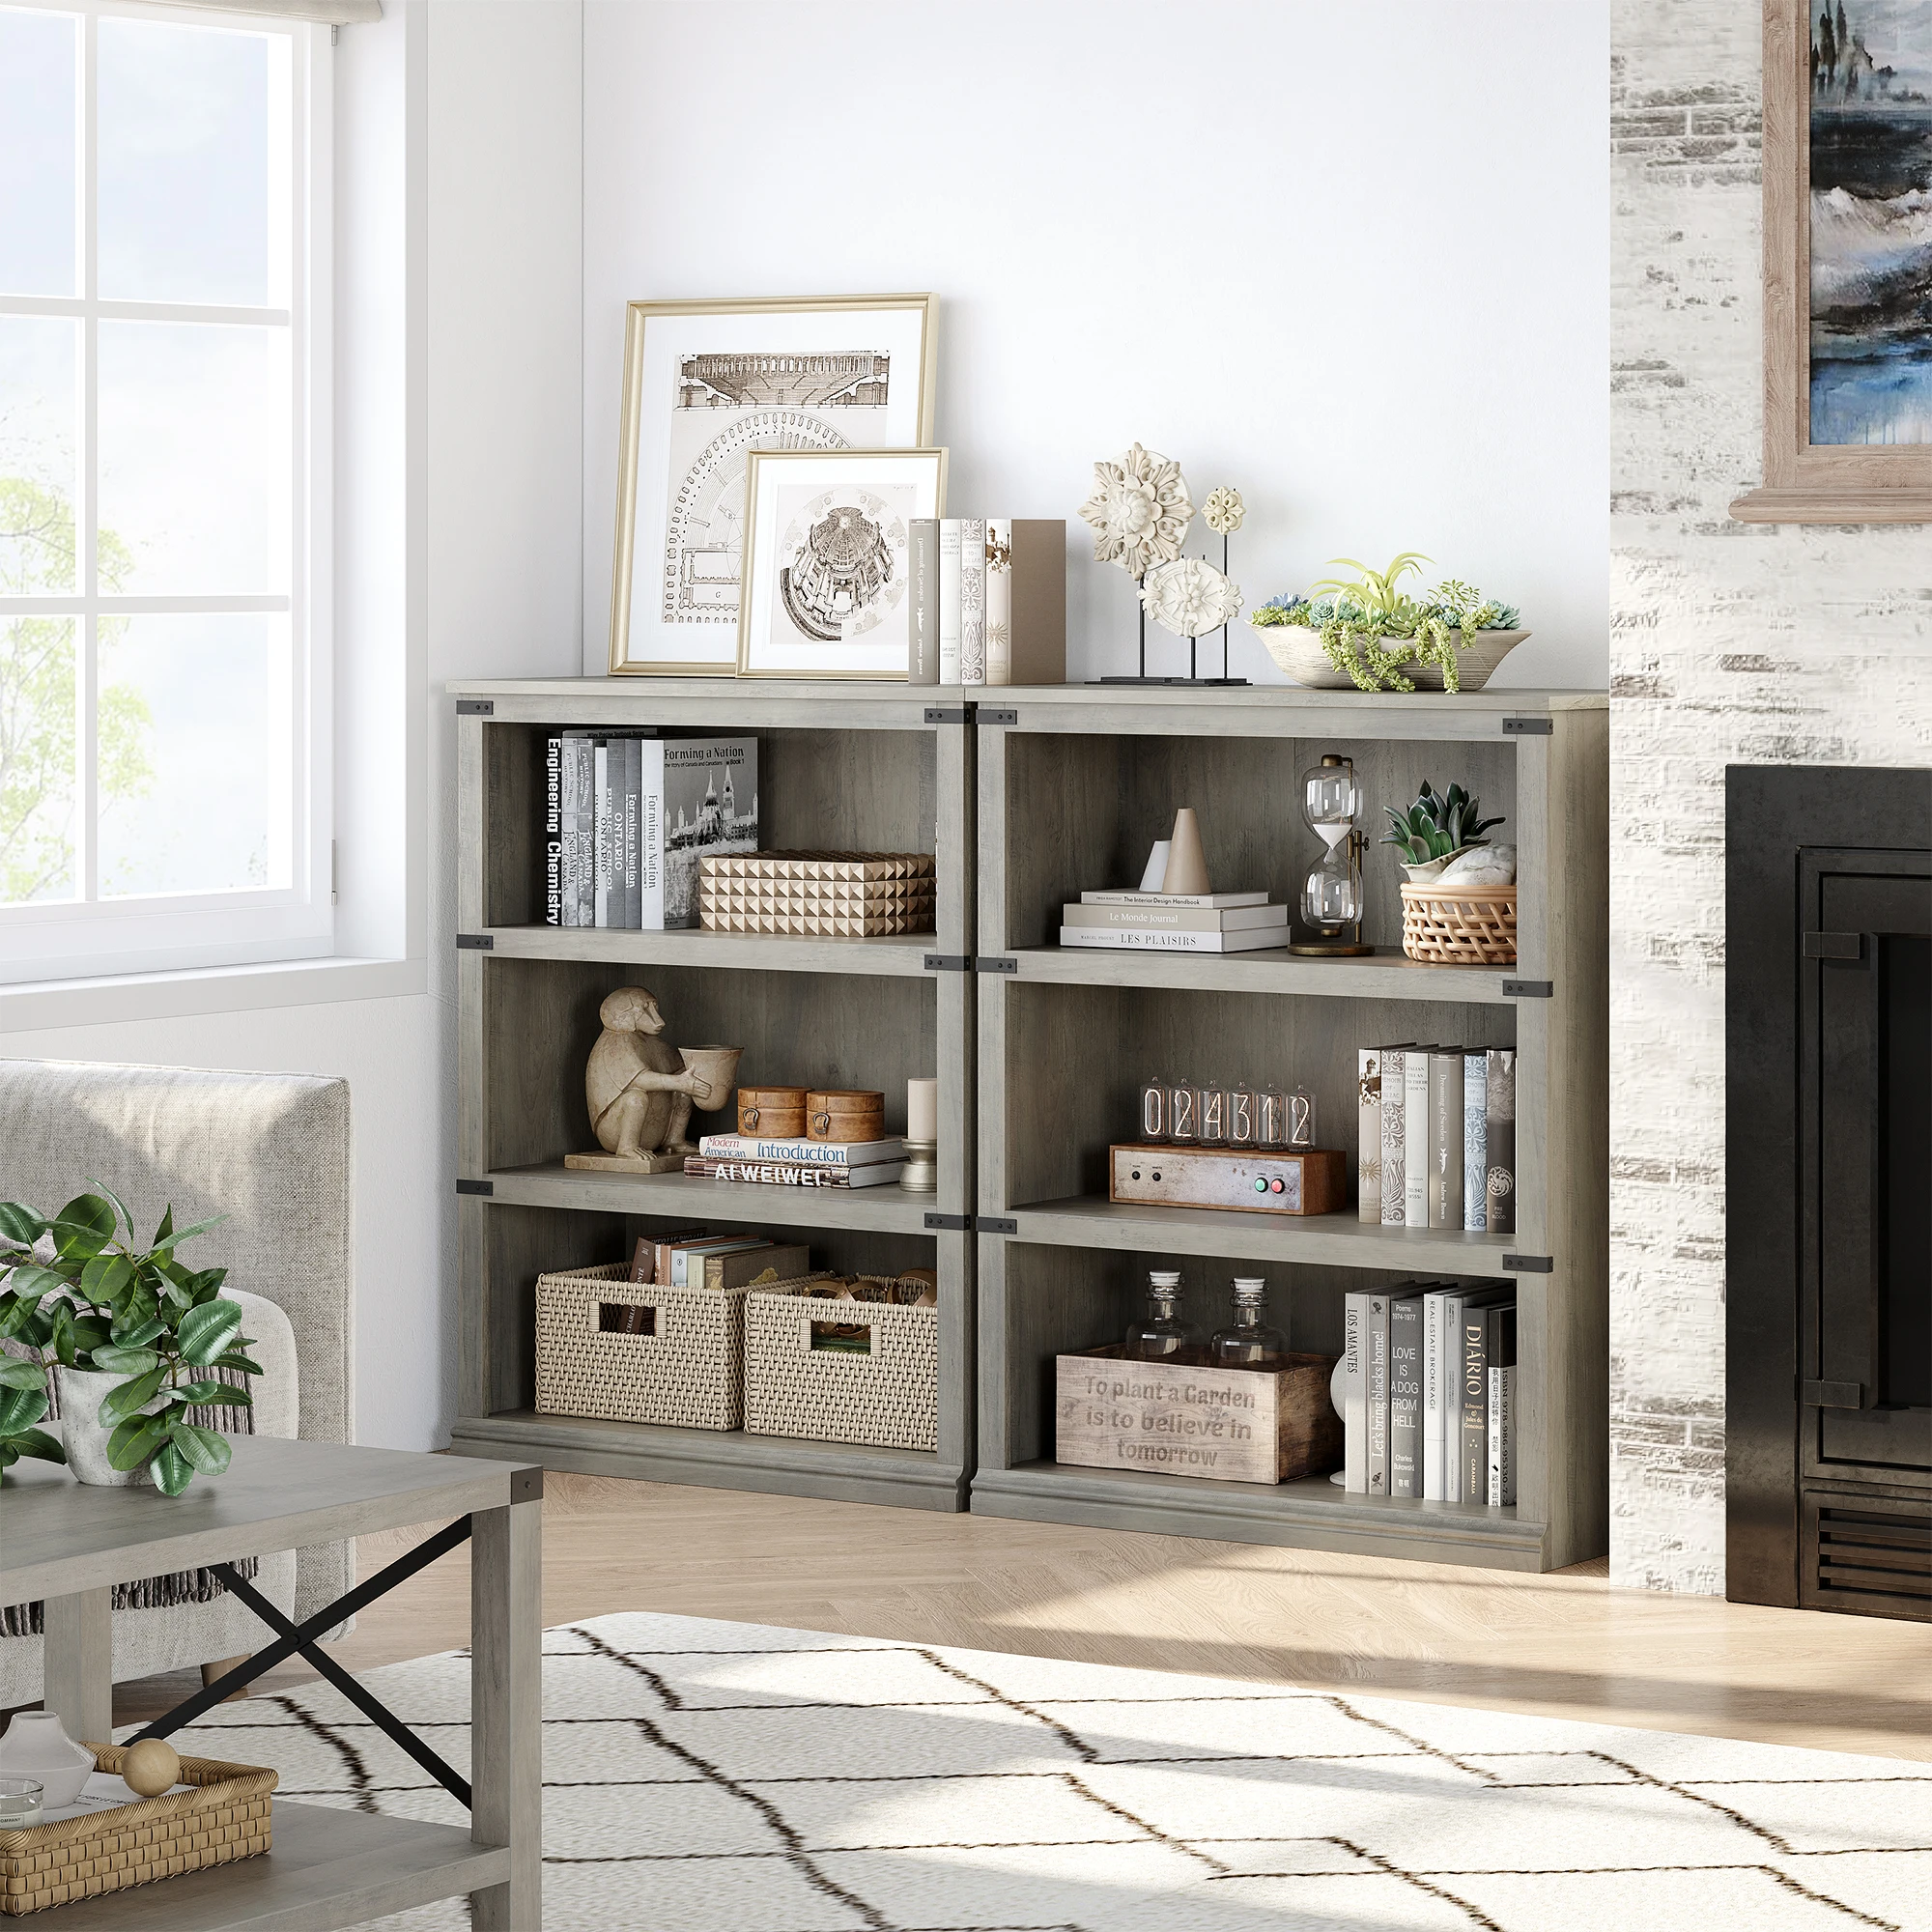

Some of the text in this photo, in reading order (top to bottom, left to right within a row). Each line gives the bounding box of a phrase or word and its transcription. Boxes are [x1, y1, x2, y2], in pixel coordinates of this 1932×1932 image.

[665, 746, 745, 760] Forming a Nation
[628, 794, 638, 841] Forming
[648, 795, 659, 841] Forming
[547, 738, 562, 925] Engineering Chemistry
[614, 812, 623, 870] ONTARIO
[629, 852, 638, 889] Nation
[648, 853, 659, 889] Nation
[1153, 897, 1172, 906] Design
[1110, 913, 1179, 923] Le Monde Journal
[1121, 934, 1140, 945] LES
[1146, 935, 1197, 947] PLAISIRS
[704, 1147, 747, 1158] American
[707, 1137, 740, 1148] Modern
[757, 1142, 846, 1163] Introduction
[715, 1163, 822, 1187] AI WEIWEI
[626, 1306, 637, 1333] CHARLO
[1348, 1309, 1358, 1374] LOS AMANTES
[1372, 1331, 1384, 1366] home!
[1393, 1347, 1416, 1360] LOVE
[1400, 1365, 1408, 1377] IS
[1466, 1324, 1486, 1396] DIÁRIO
[1085, 1376, 1256, 1409] To plant a Garden
[1372, 1367, 1384, 1401] blacks
[1391, 1381, 1419, 1394] A DOG
[1372, 1402, 1388, 1431] bring
[1392, 1398, 1417, 1411] FROM
[1087, 1406, 1252, 1440] is to believe in
[1393, 1414, 1416, 1429] HELL
[1118, 1438, 1218, 1467] tomorrow
[1394, 1463, 1415, 1472] Bukowski
